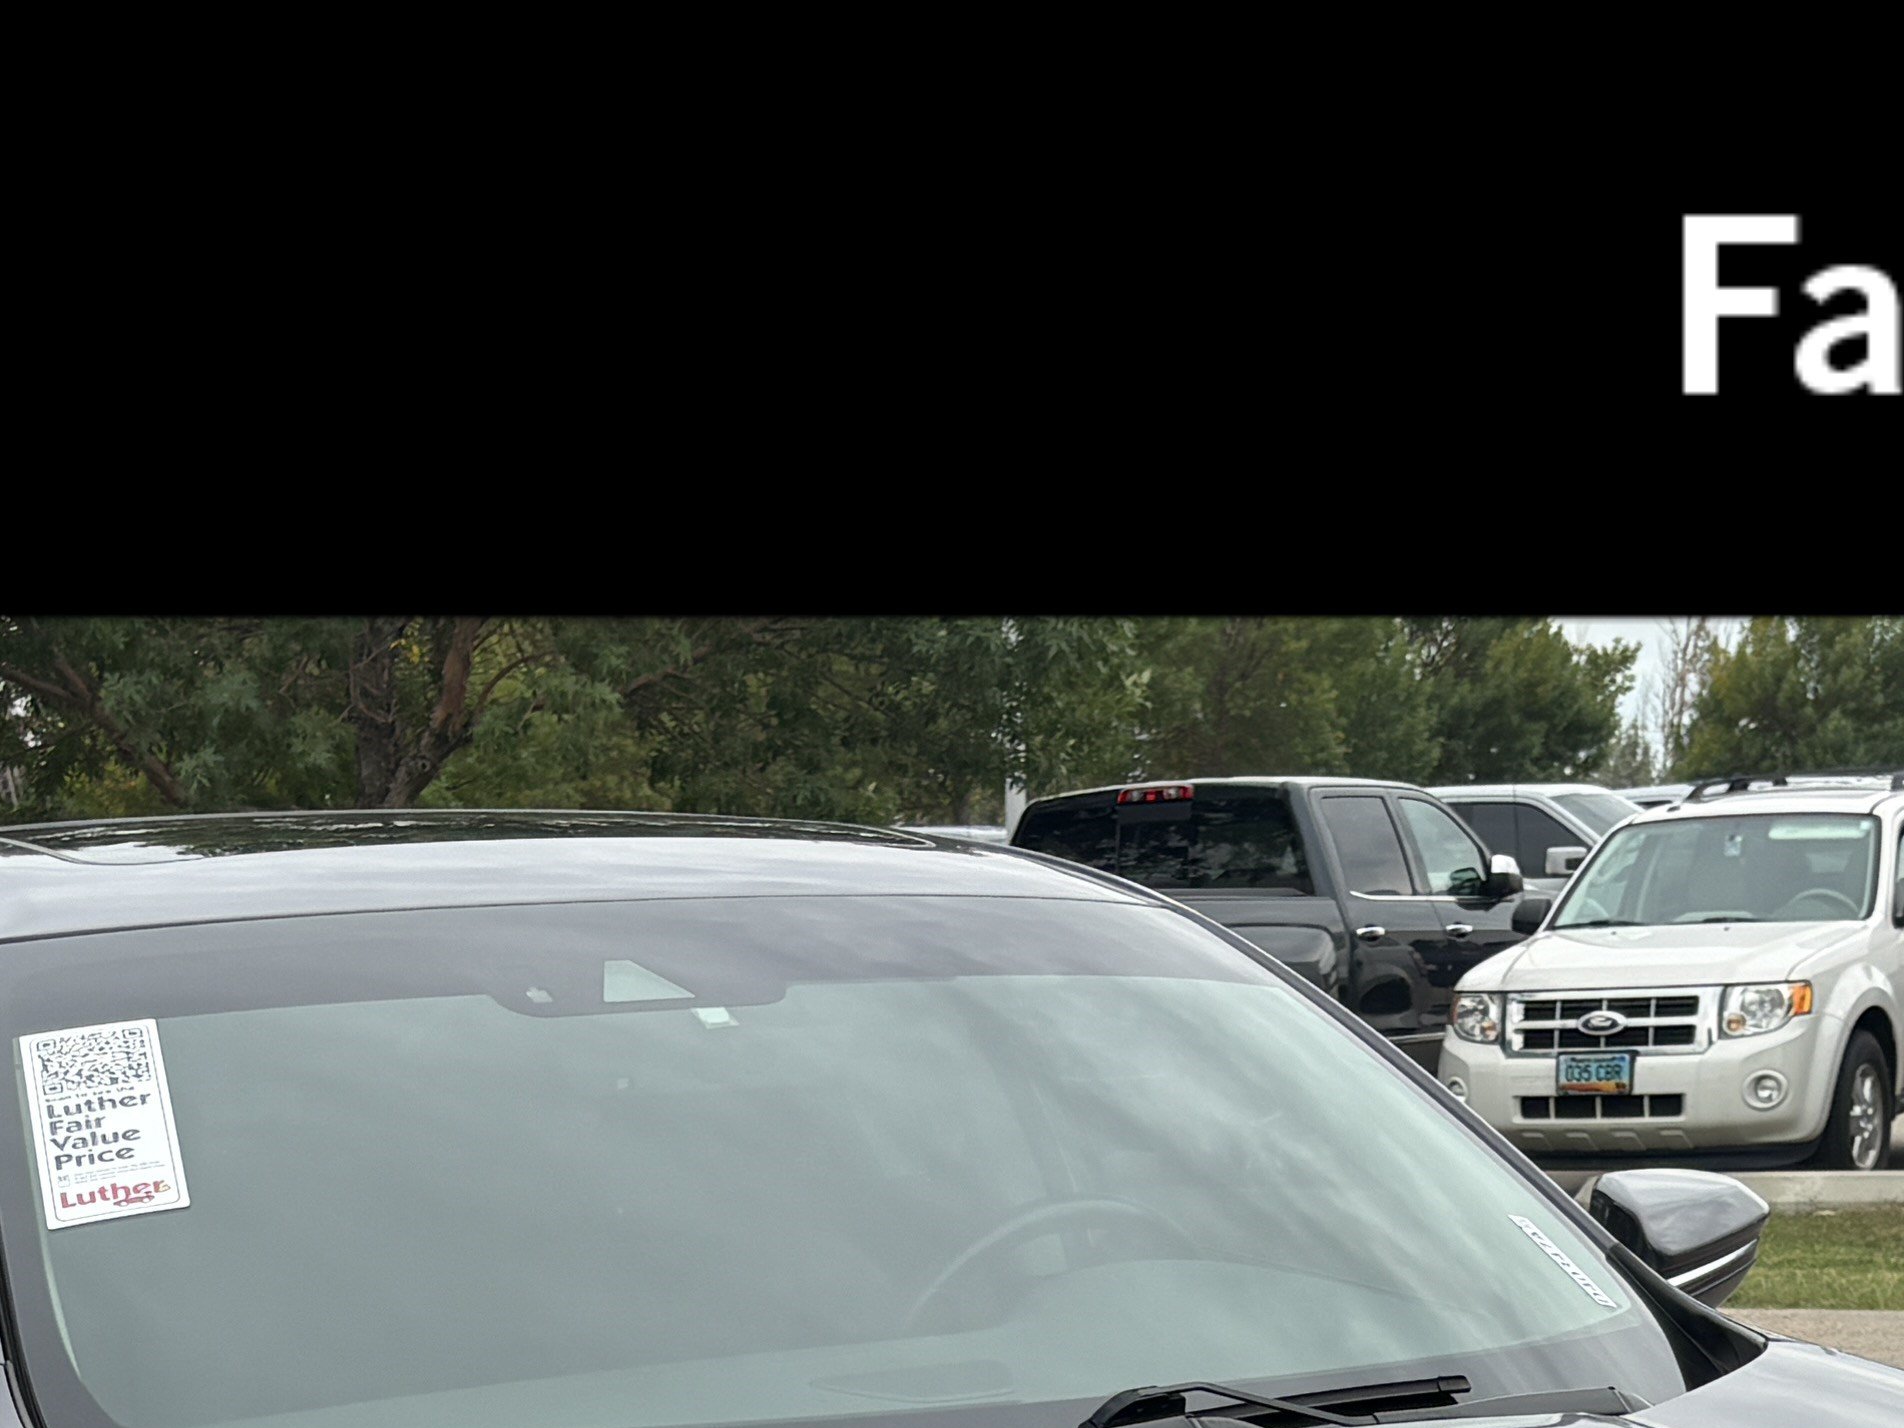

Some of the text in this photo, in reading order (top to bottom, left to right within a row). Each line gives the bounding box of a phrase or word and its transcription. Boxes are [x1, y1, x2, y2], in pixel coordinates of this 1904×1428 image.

[46, 1093, 151, 1119] Luther
[49, 1115, 106, 1136] Fair
[49, 1129, 142, 1152] Value
[54, 1147, 135, 1171] Price
[59, 1180, 166, 1209] Luther
